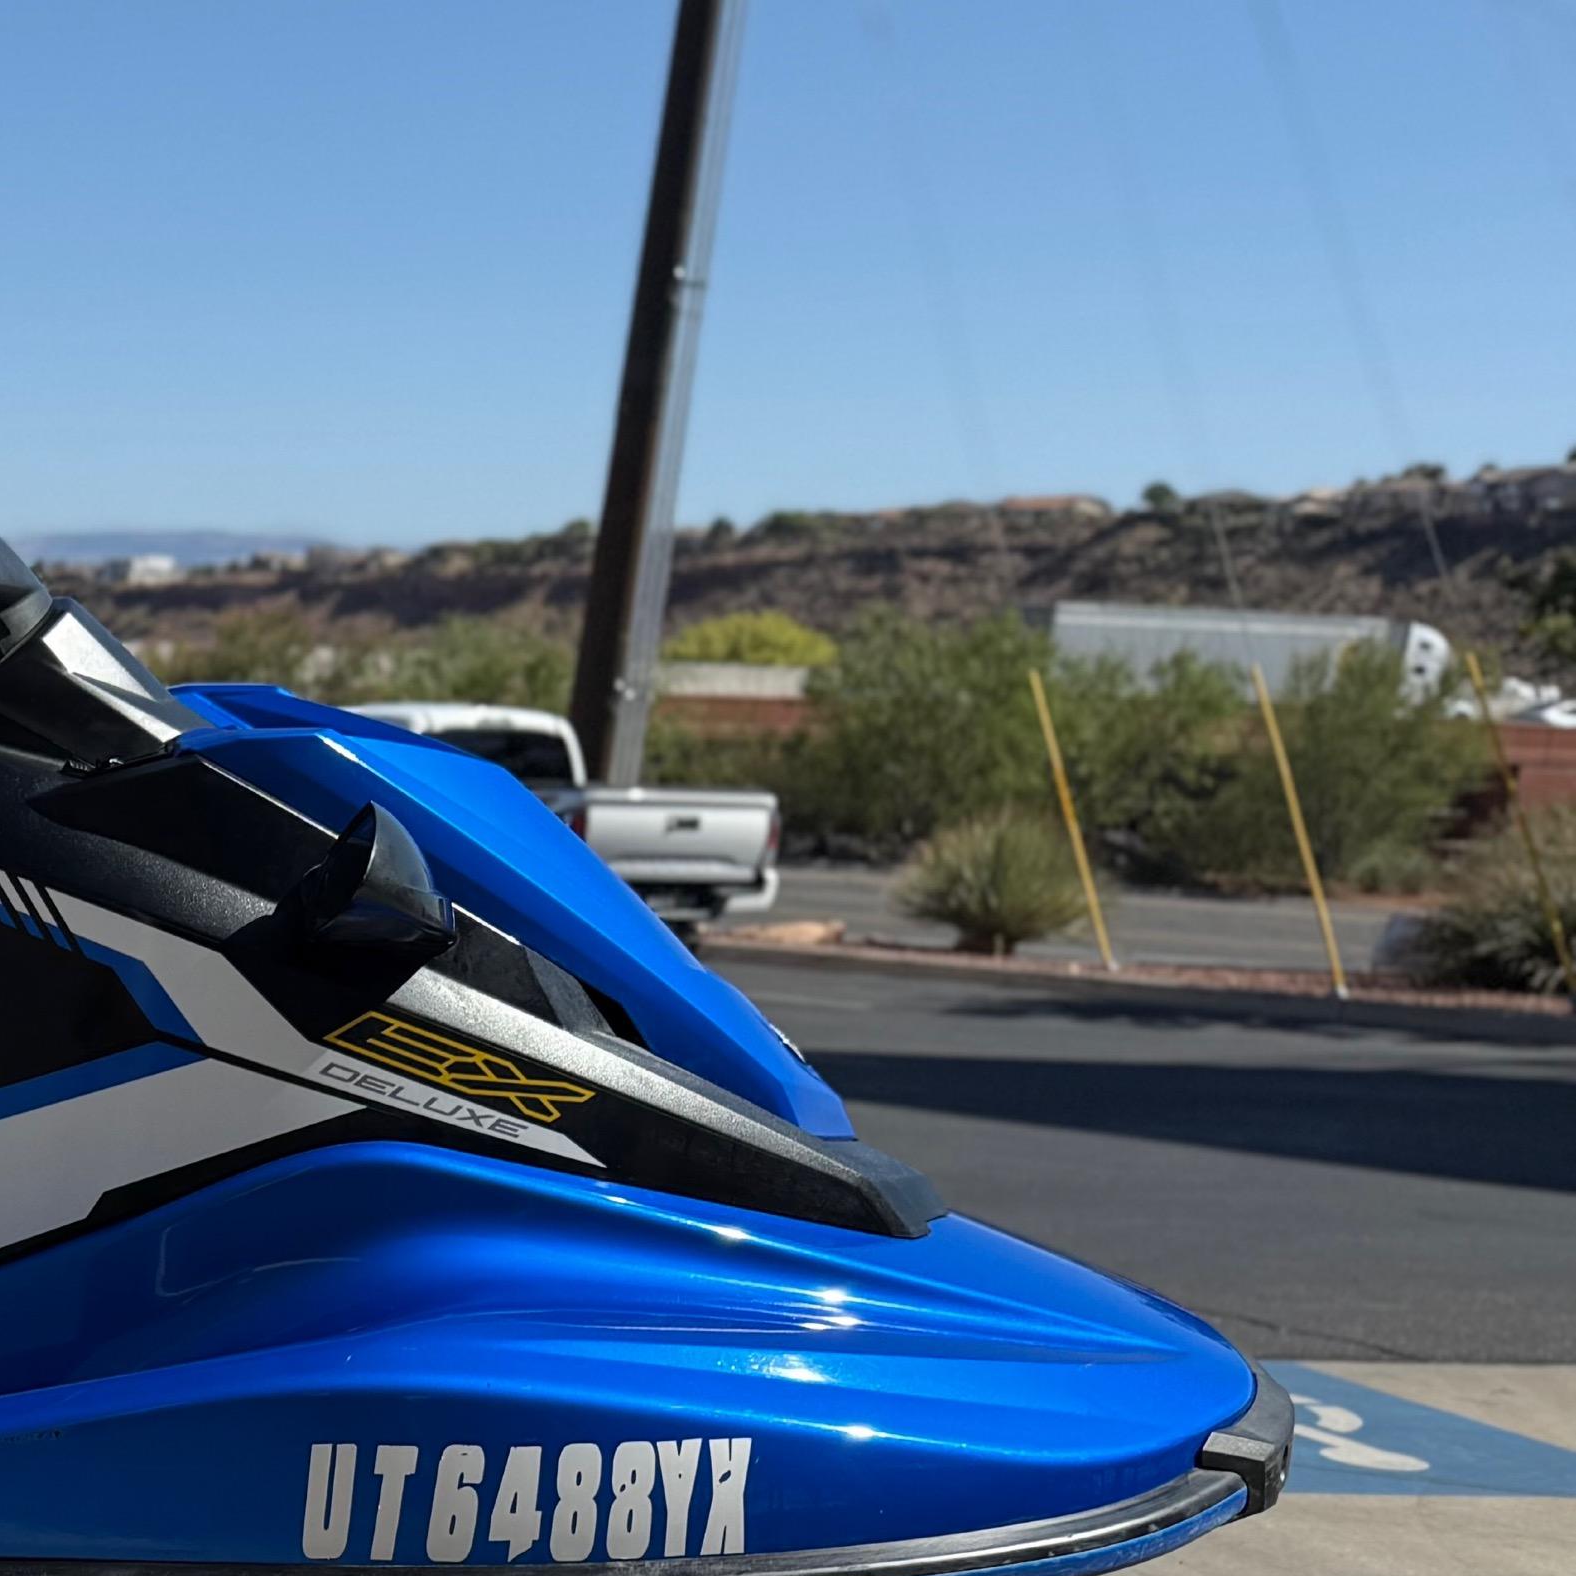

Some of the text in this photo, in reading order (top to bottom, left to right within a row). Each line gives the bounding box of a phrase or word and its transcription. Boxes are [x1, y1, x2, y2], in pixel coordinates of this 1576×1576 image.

[319, 1062, 529, 1138] DELUXE
[323, 1011, 596, 1123] EX
[302, 1438, 751, 1562] UT6488YX
